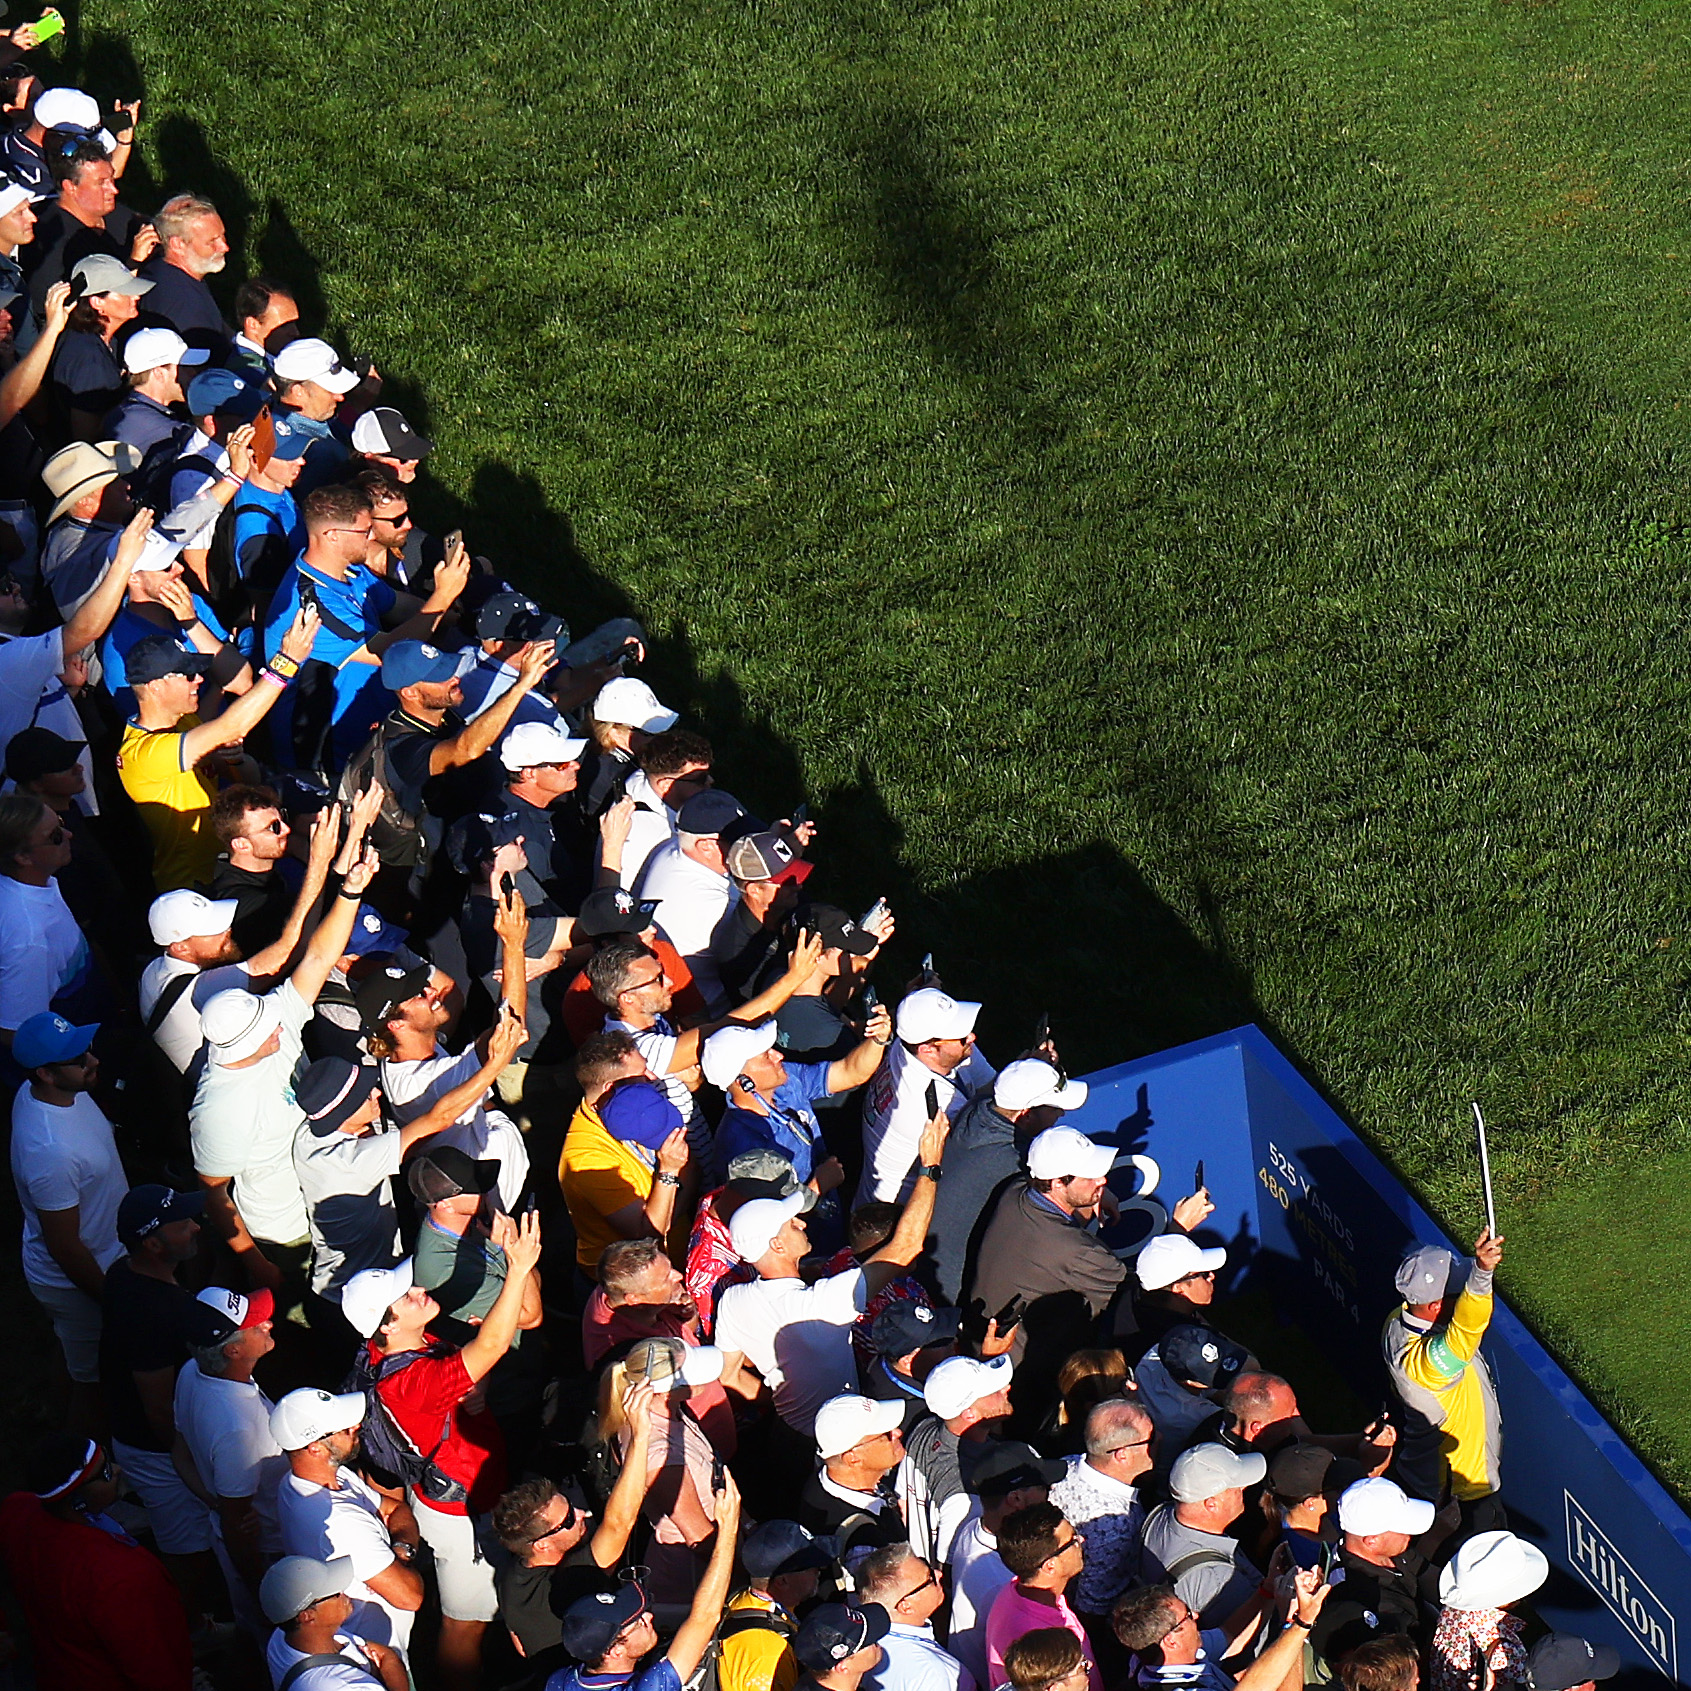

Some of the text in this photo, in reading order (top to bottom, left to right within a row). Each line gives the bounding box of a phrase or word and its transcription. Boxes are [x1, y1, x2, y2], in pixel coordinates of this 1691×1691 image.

[1257, 1166, 1357, 1289] 480 METRES
[1268, 1141, 1355, 1253] 525 YARDS
[1312, 1256, 1360, 1326] PAR 4
[1573, 1514, 1669, 1663] Hilton
